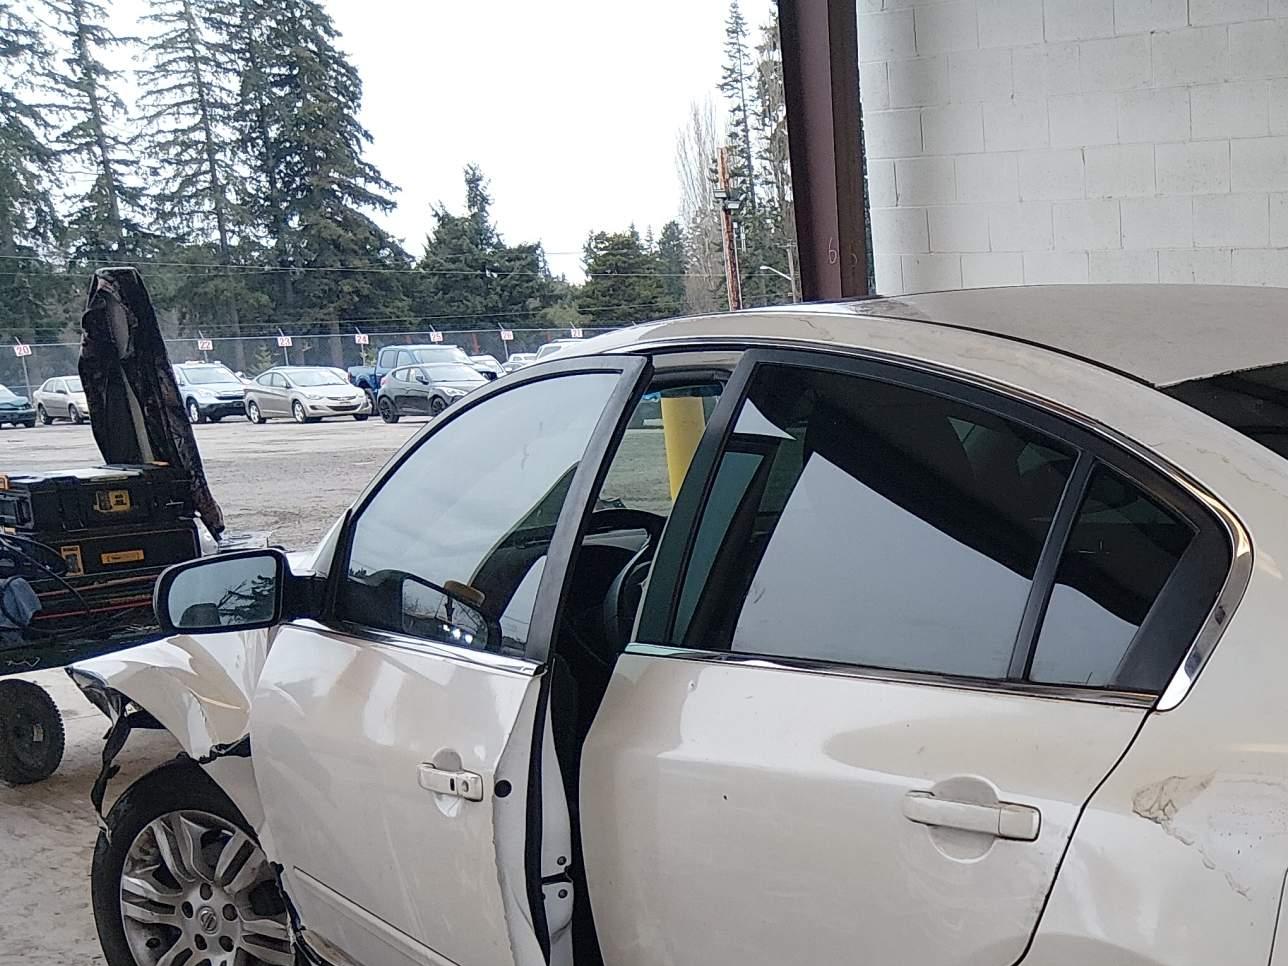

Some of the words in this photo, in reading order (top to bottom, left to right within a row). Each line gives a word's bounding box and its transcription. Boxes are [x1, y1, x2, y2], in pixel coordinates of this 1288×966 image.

[356, 335, 367, 343] 24
[431, 332, 442, 341] 25
[199, 340, 211, 349] 22
[279, 337, 291, 346] 23
[16, 345, 29, 355] 20
